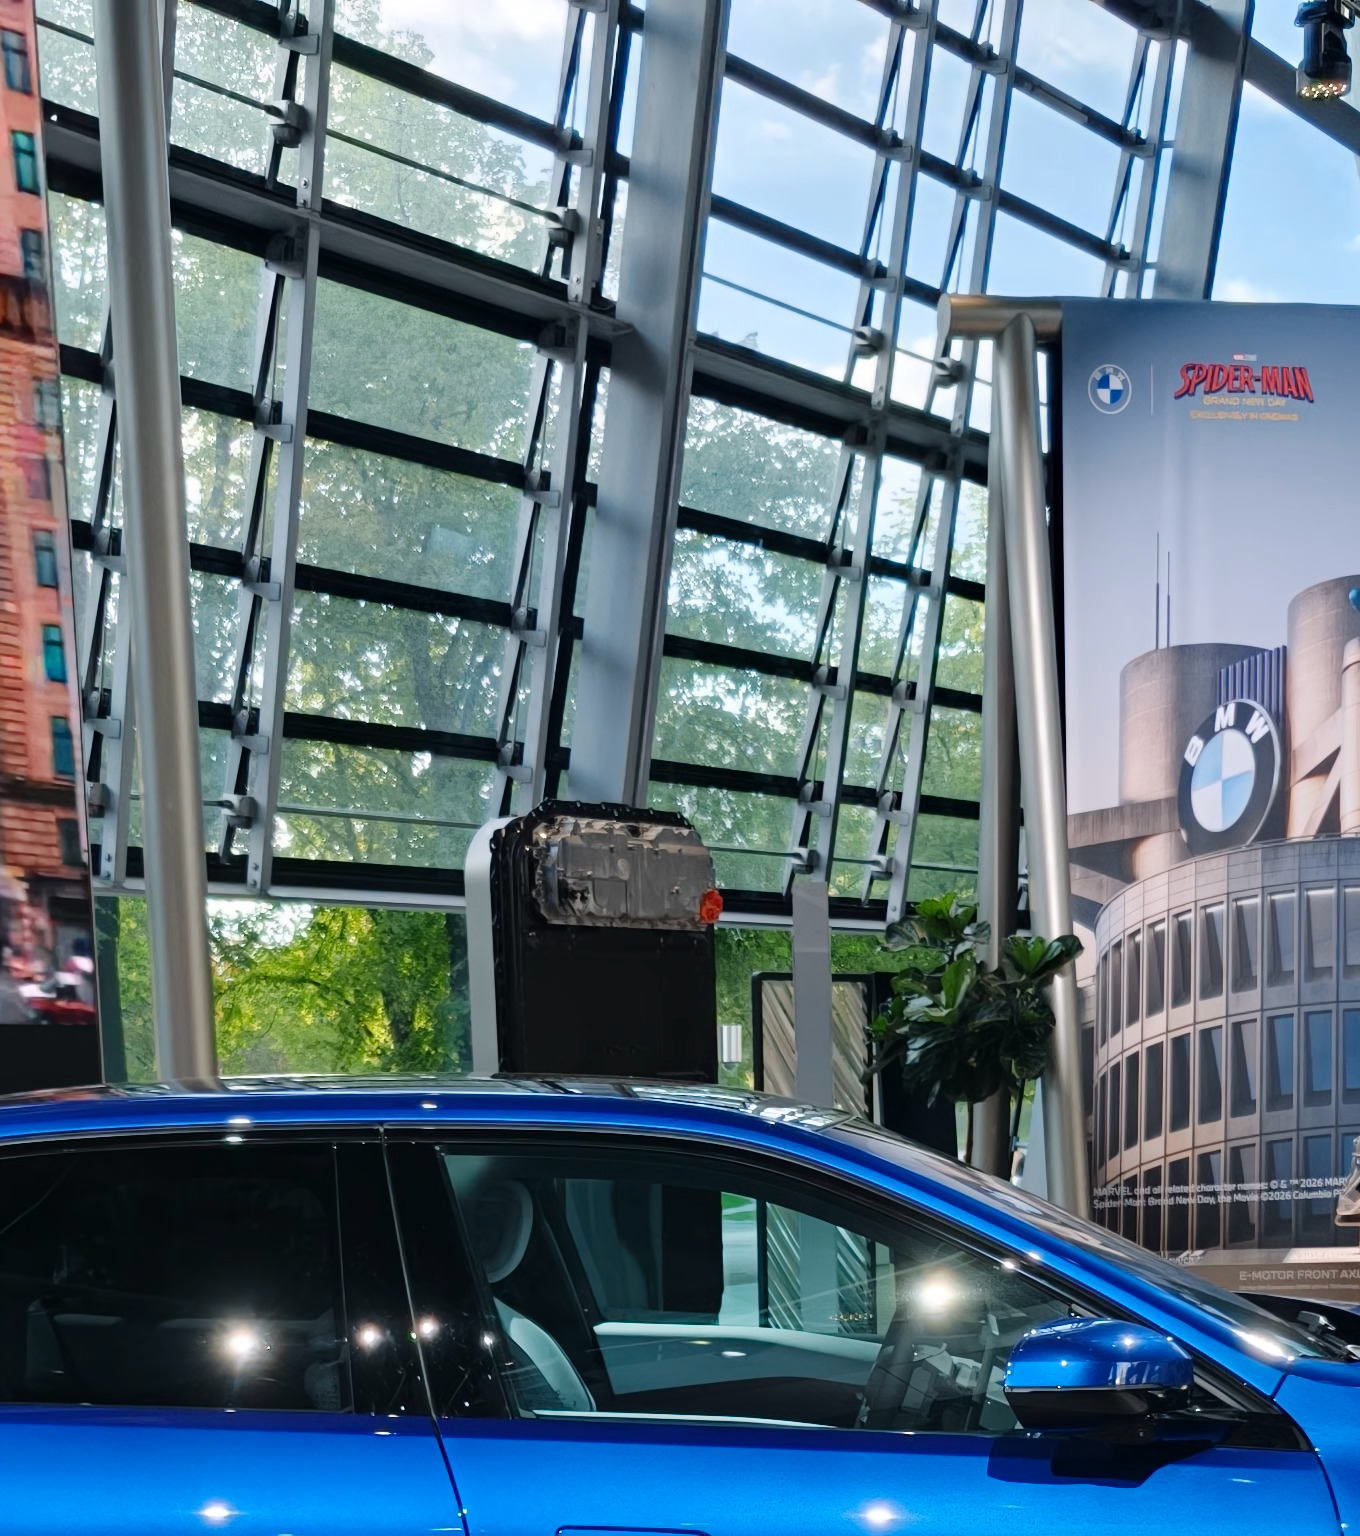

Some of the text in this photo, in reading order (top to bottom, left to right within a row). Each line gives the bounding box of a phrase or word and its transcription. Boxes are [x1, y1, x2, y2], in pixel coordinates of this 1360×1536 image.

[1174, 363, 1315, 403] SPIDER-MAN
[1203, 396, 1239, 406] BRAND
[1184, 702, 1270, 768] BMW
[1093, 1186, 1132, 1197] MARVEL
[1134, 1186, 1151, 1195] and
[1280, 1179, 1288, 1189] &
[1300, 1178, 1323, 1188] 2026
[1148, 1196, 1174, 1207] Brand
[1176, 1195, 1195, 1206] New
[1197, 1194, 1216, 1205] Day,
[1217, 1194, 1232, 1203] the
[1233, 1193, 1259, 1202] Movie
[1292, 1189, 1332, 1200] Columbia
[1240, 1270, 1294, 1281] E-MOTOR
[1297, 1269, 1339, 1280] FRONT
